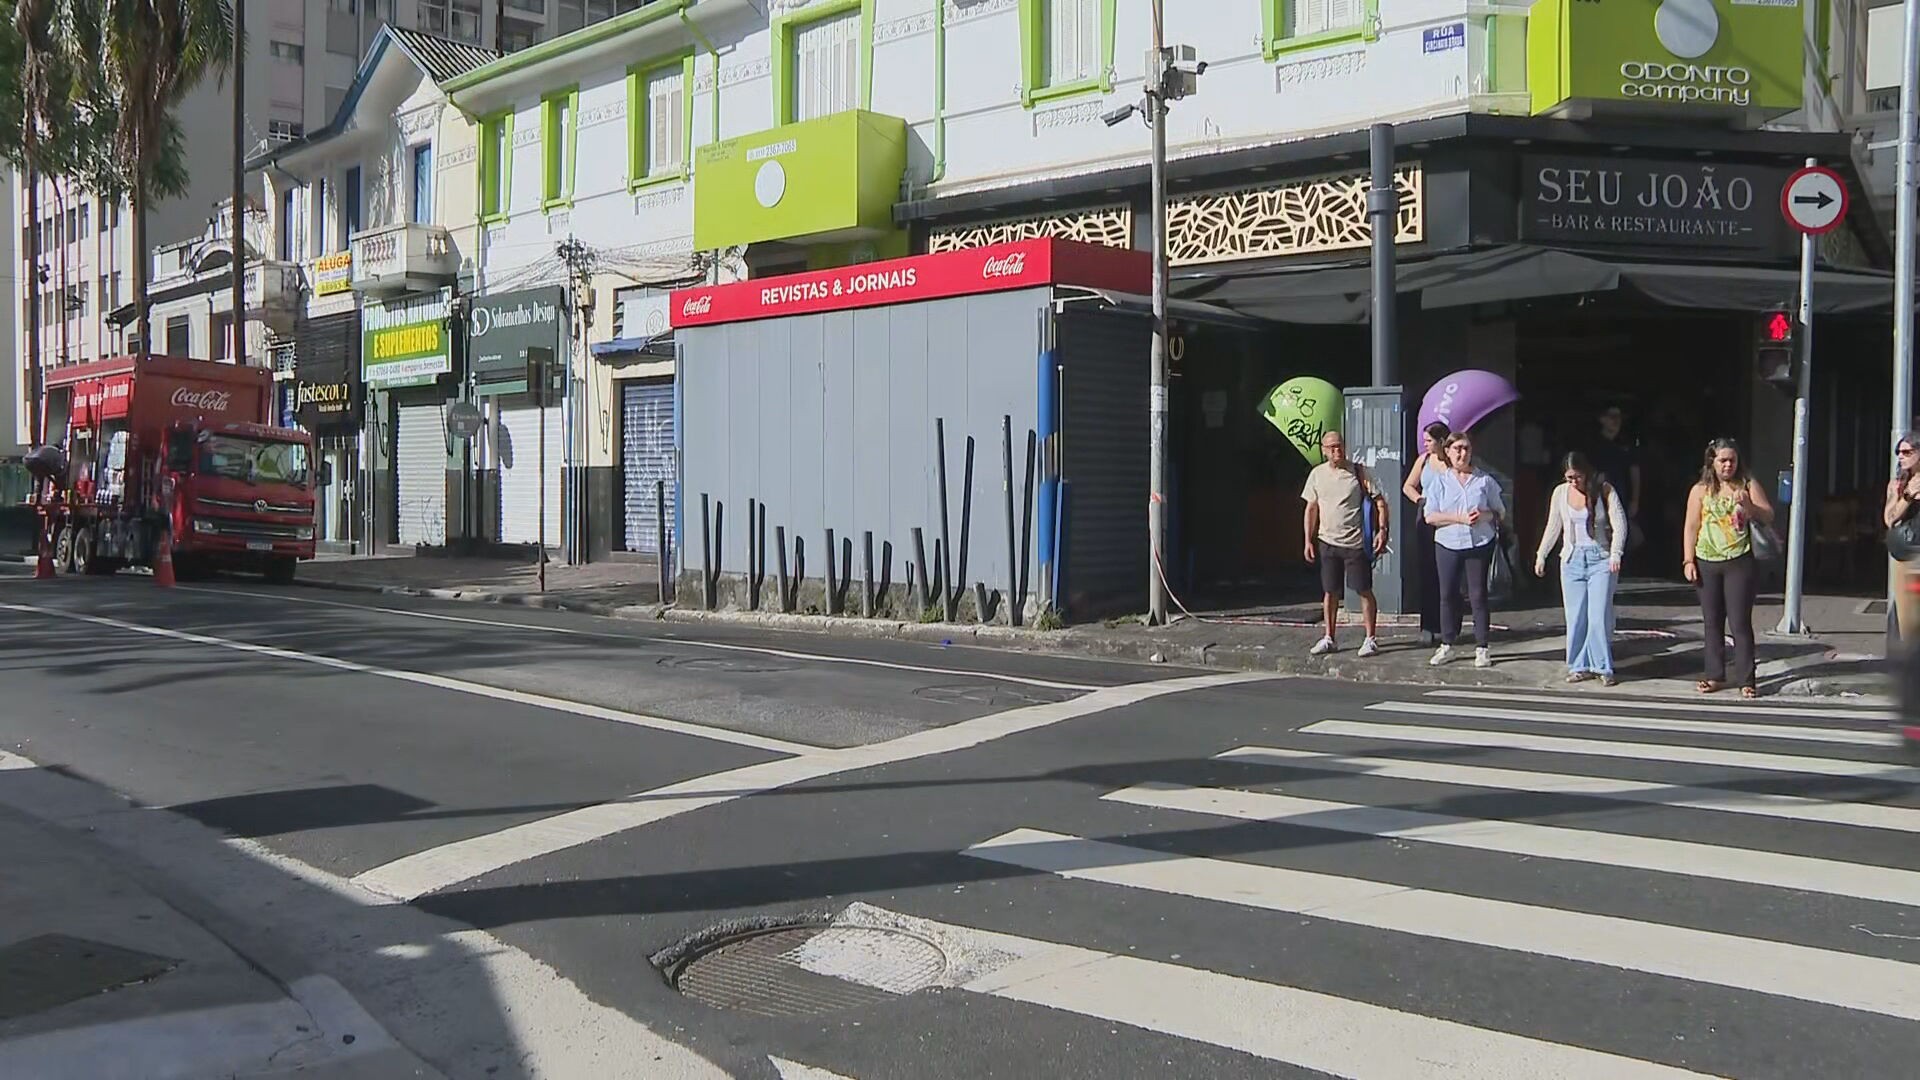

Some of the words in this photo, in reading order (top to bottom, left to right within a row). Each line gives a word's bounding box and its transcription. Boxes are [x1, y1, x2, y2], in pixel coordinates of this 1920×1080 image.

[1620, 62, 1750, 85] ODONTO
[1620, 84, 1750, 106] company
[1538, 167, 1622, 206] SEU
[1637, 166, 1753, 211] JOÃO
[1551, 213, 1589, 231] BAR
[1594, 216, 1606, 231] &
[1611, 216, 1739, 237] RESTAURANTE
[318, 254, 352, 272] ALUGA
[983, 252, 1028, 280] Coca-Cola
[761, 285, 829, 306] REVISTAS
[832, 278, 844, 297] &
[846, 267, 918, 295] JORNAIS
[491, 304, 531, 328] Sobrancelhas
[533, 301, 555, 324] Design
[683, 295, 713, 318] Coca-Cola
[374, 333, 380, 359] E
[380, 324, 439, 358] SUPLEMENTOS
[171, 387, 231, 411] Coca-Cola
